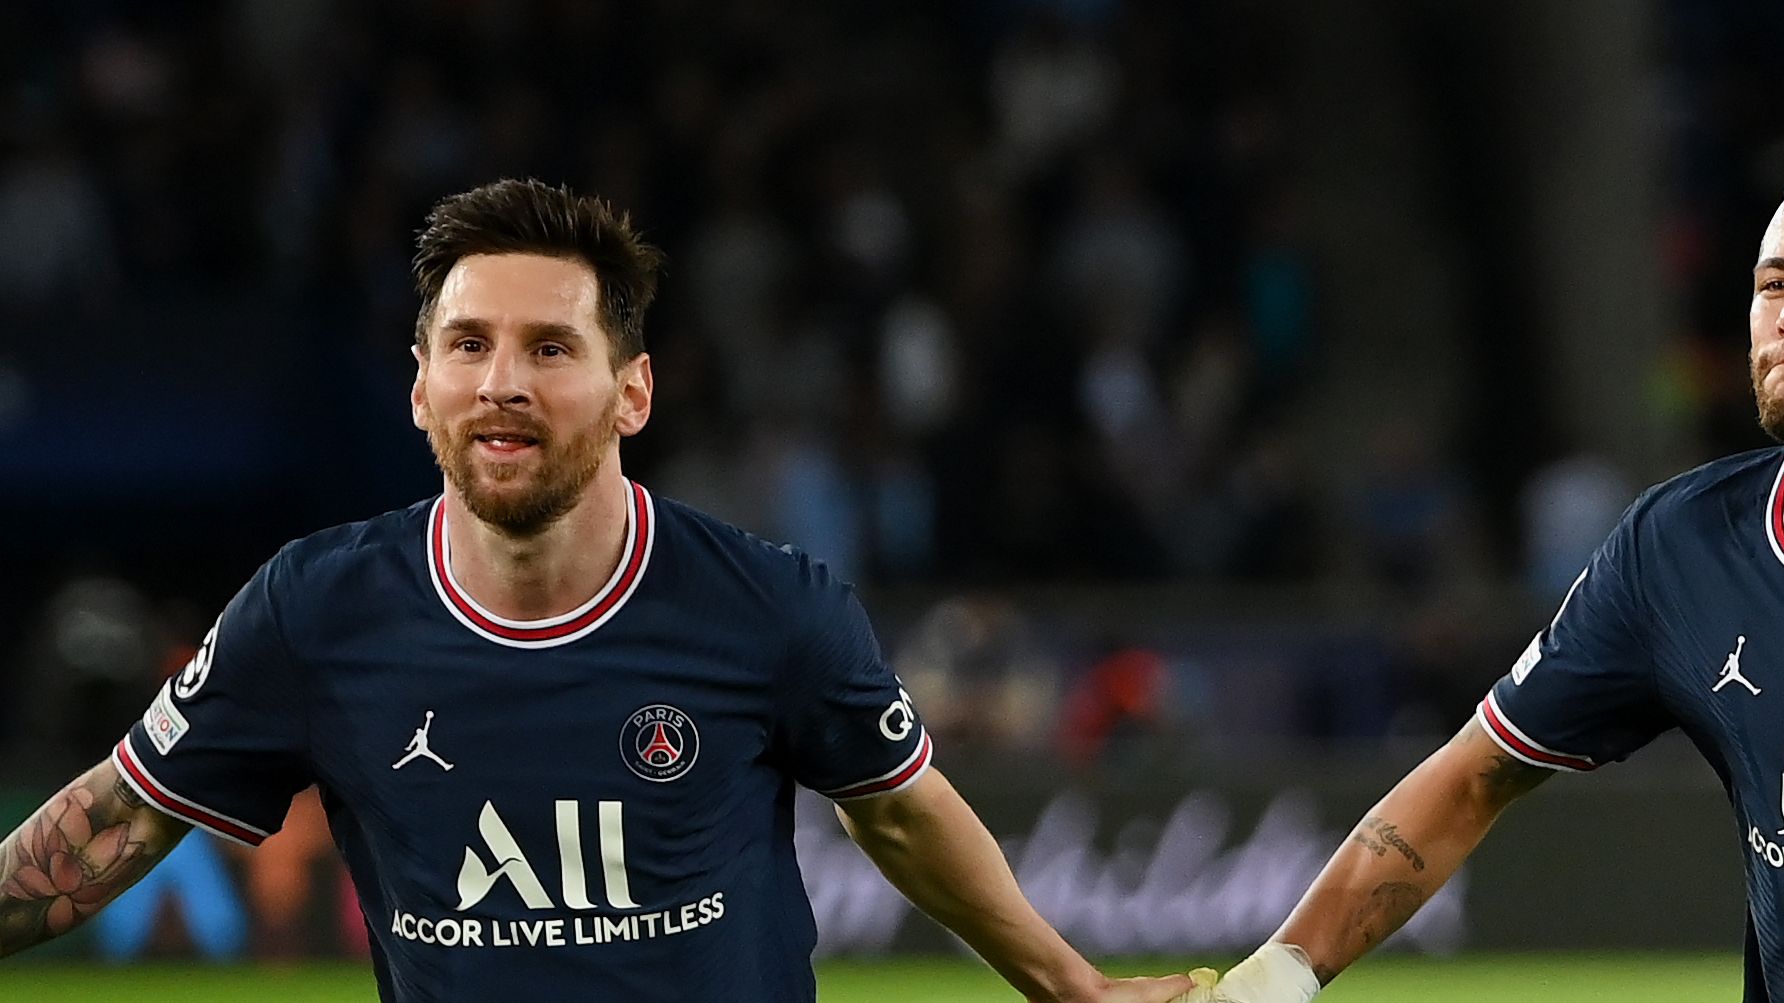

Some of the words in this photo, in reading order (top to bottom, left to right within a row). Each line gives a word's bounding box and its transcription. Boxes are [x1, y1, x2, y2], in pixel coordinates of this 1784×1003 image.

[633, 708, 685, 728] PARIS
[391, 909, 484, 947] ACCOR
[492, 918, 567, 947] LIVE
[575, 891, 725, 945] LIMITLESS
